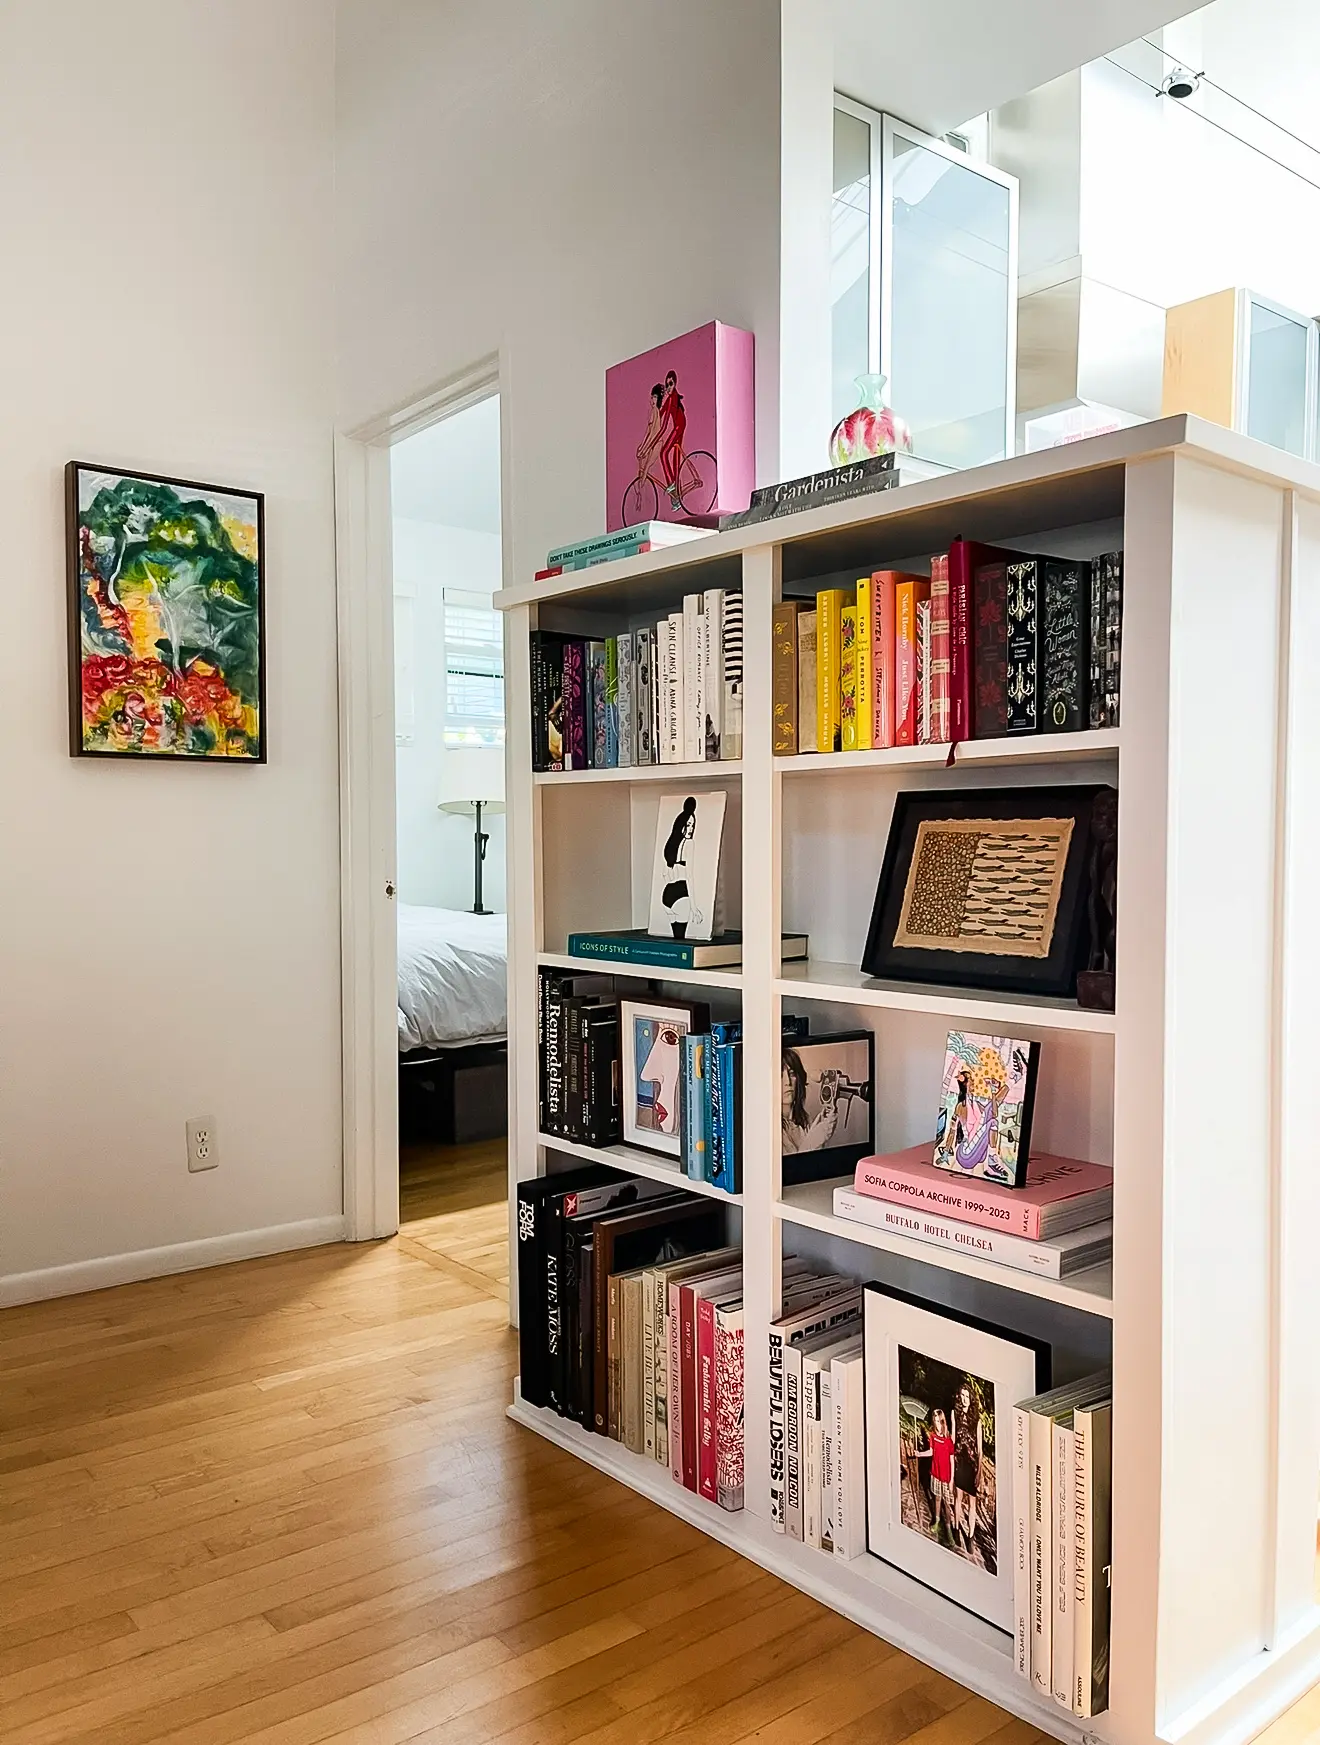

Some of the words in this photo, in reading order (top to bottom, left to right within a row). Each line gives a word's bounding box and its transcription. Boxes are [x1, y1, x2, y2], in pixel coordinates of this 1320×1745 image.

[775, 467, 863, 502] Gardenista
[549, 553, 563, 562] DON'T
[563, 550, 574, 559] TAKE
[574, 546, 588, 557] THESE
[588, 539, 611, 552] DRAWINGS
[612, 531, 637, 545] SERIOUSLY
[900, 594, 909, 614] Nick
[669, 622, 677, 641] SKIN
[900, 616, 909, 650] Hornby
[1047, 612, 1073, 636] Little
[1044, 630, 1077, 652] Women
[669, 644, 677, 674] CLEANSE
[900, 660, 909, 678] Just
[900, 681, 909, 702] Like
[900, 704, 909, 720] You
[579, 943, 599, 952] ICONS
[599, 944, 608, 953] OF
[609, 945, 629, 954] STYLE
[549, 1004, 561, 1114] Remodelista
[864, 1174, 887, 1189] SOFIA
[888, 1180, 926, 1199] COPPOLA
[926, 1190, 962, 1208] ARCHIVE
[519, 1200, 528, 1241] FORD
[525, 1202, 535, 1238] TOM
[885, 1212, 920, 1231] BUFFALO
[924, 1222, 951, 1240] HOTEL
[954, 1232, 993, 1252] CHELSEA
[565, 1232, 575, 1287] GLOSS
[547, 1254, 558, 1302] KATE
[656, 1280, 664, 1336] HOMEWORKS
[547, 1304, 558, 1356] MOSS
[645, 1323, 653, 1354] LIVE
[672, 1351, 678, 1366] OF
[769, 1333, 784, 1417] BEAUTIFUL
[788, 1375, 798, 1398] KIM
[645, 1356, 653, 1428] BEAUTIFUL
[805, 1371, 816, 1419] Ripped
[788, 1400, 798, 1452] GORDON
[769, 1420, 784, 1482] LOSERS
[1075, 1430, 1085, 1460] THE
[788, 1456, 798, 1475] NO
[788, 1476, 798, 1508] ICON
[1075, 1462, 1085, 1520] ALLURE
[1075, 1522, 1085, 1544] OF
[1075, 1546, 1085, 1606] BEAUTY
[1035, 1595, 1042, 1604] TO
[1035, 1624, 1042, 1634] ME
